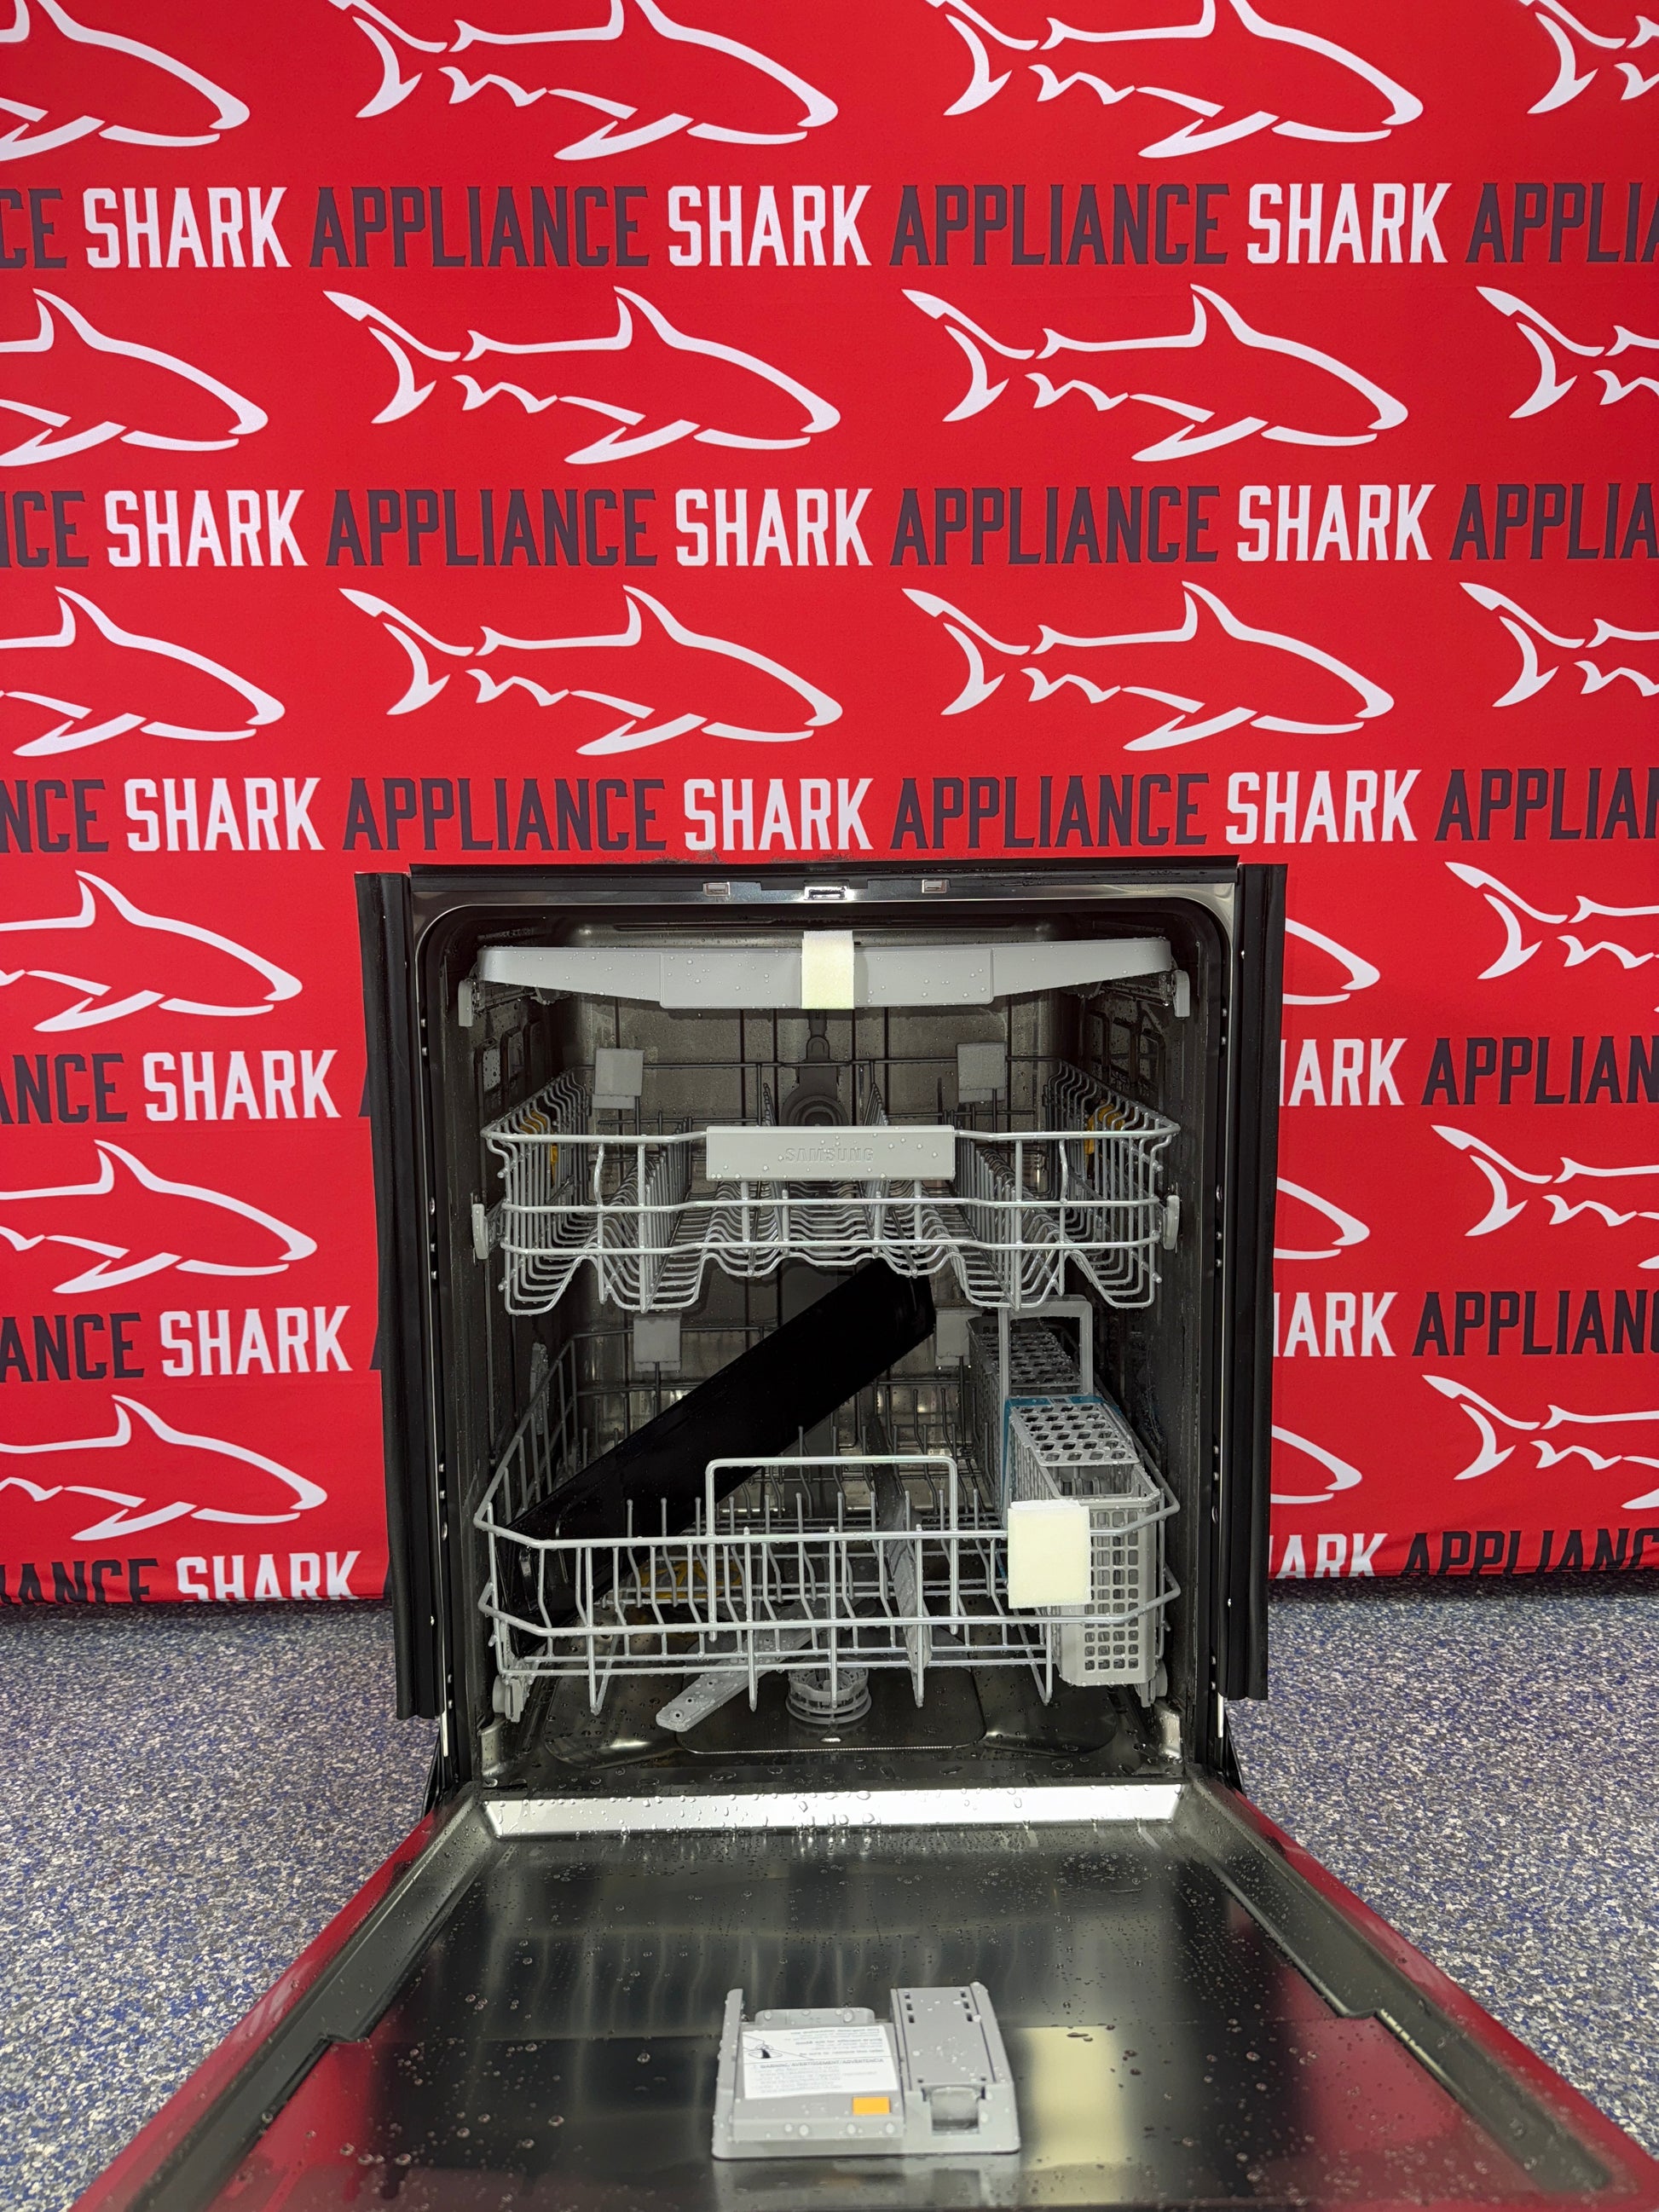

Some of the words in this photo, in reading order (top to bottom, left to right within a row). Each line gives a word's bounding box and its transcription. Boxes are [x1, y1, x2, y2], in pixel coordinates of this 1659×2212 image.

[84, 187, 292, 269] SHARK
[309, 187, 649, 268] APPLIANCE
[668, 185, 871, 267] SHARK
[890, 184, 1228, 266] APPLIANCE
[1246, 182, 1452, 264] SHARK
[0, 491, 89, 568] CE
[104, 489, 309, 568] SHARK
[327, 489, 656, 566] APPLIANCE
[675, 488, 873, 567] SHARK
[891, 487, 1219, 566] APPLIANCE
[1237, 484, 1436, 562] SHARK
[1449, 483, 1659, 560] APPLIA
[124, 777, 325, 852] SHARK
[343, 778, 666, 851] APPLIANCE
[684, 777, 874, 851] SHARK
[891, 773, 1208, 850] APPLIANCE
[1225, 769, 1421, 845] SHARK
[142, 1049, 341, 1122] SHARK
[1279, 1037, 1408, 1107] ARK
[785, 1147, 874, 1163] SAMSUNG
[159, 1305, 352, 1377] SHARK
[1273, 1291, 1398, 1357] ARK
[1412, 1289, 1659, 1356] APPLIAN
[176, 1550, 362, 1601] SHARK
